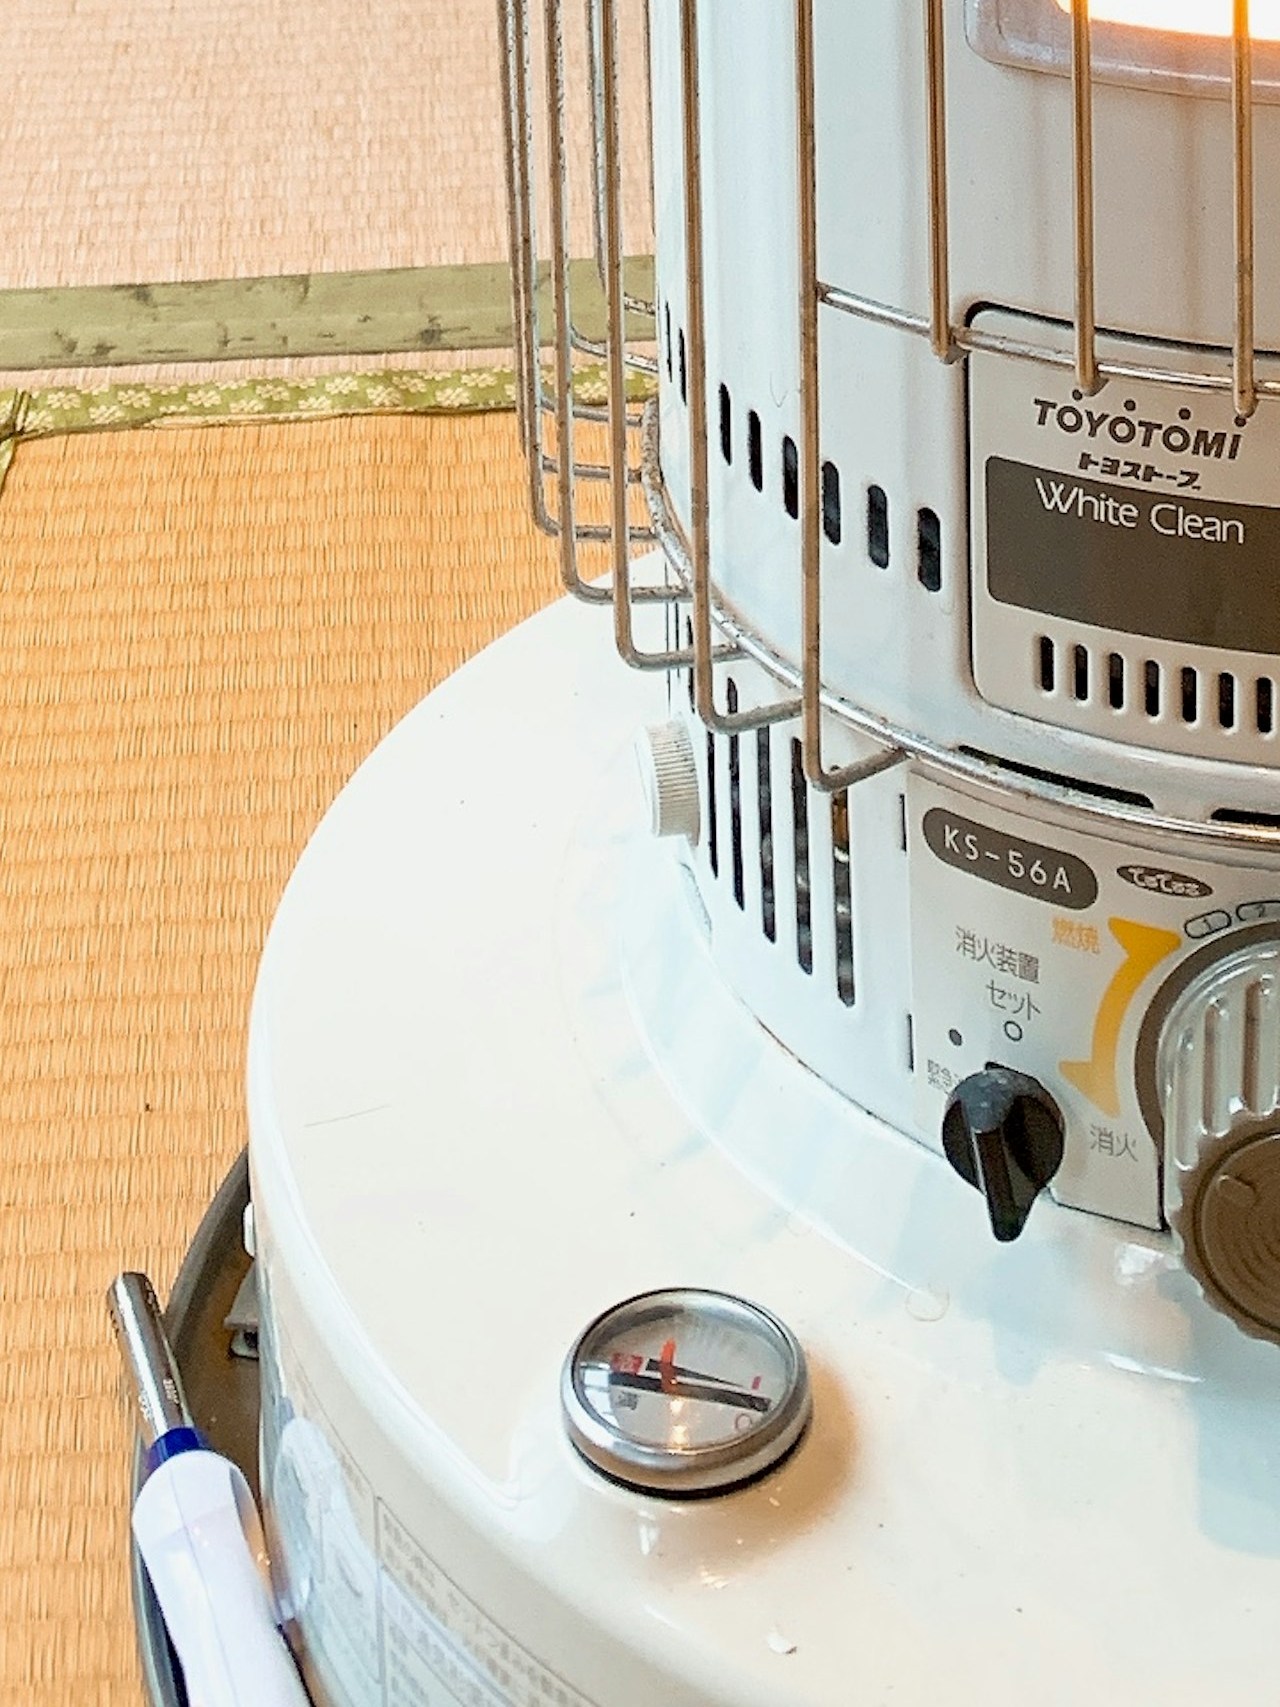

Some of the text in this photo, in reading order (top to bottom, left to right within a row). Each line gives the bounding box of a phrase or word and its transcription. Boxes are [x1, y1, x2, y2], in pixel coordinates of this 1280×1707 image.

[1034, 393, 1243, 461] TOYOTOMI
[1035, 477, 1245, 544] White Clean
[943, 824, 1073, 894] KS-56A
[955, 925, 1040, 984] 消火装置
[985, 979, 1041, 1021] セット
[1089, 1123, 1139, 1162] 消火
